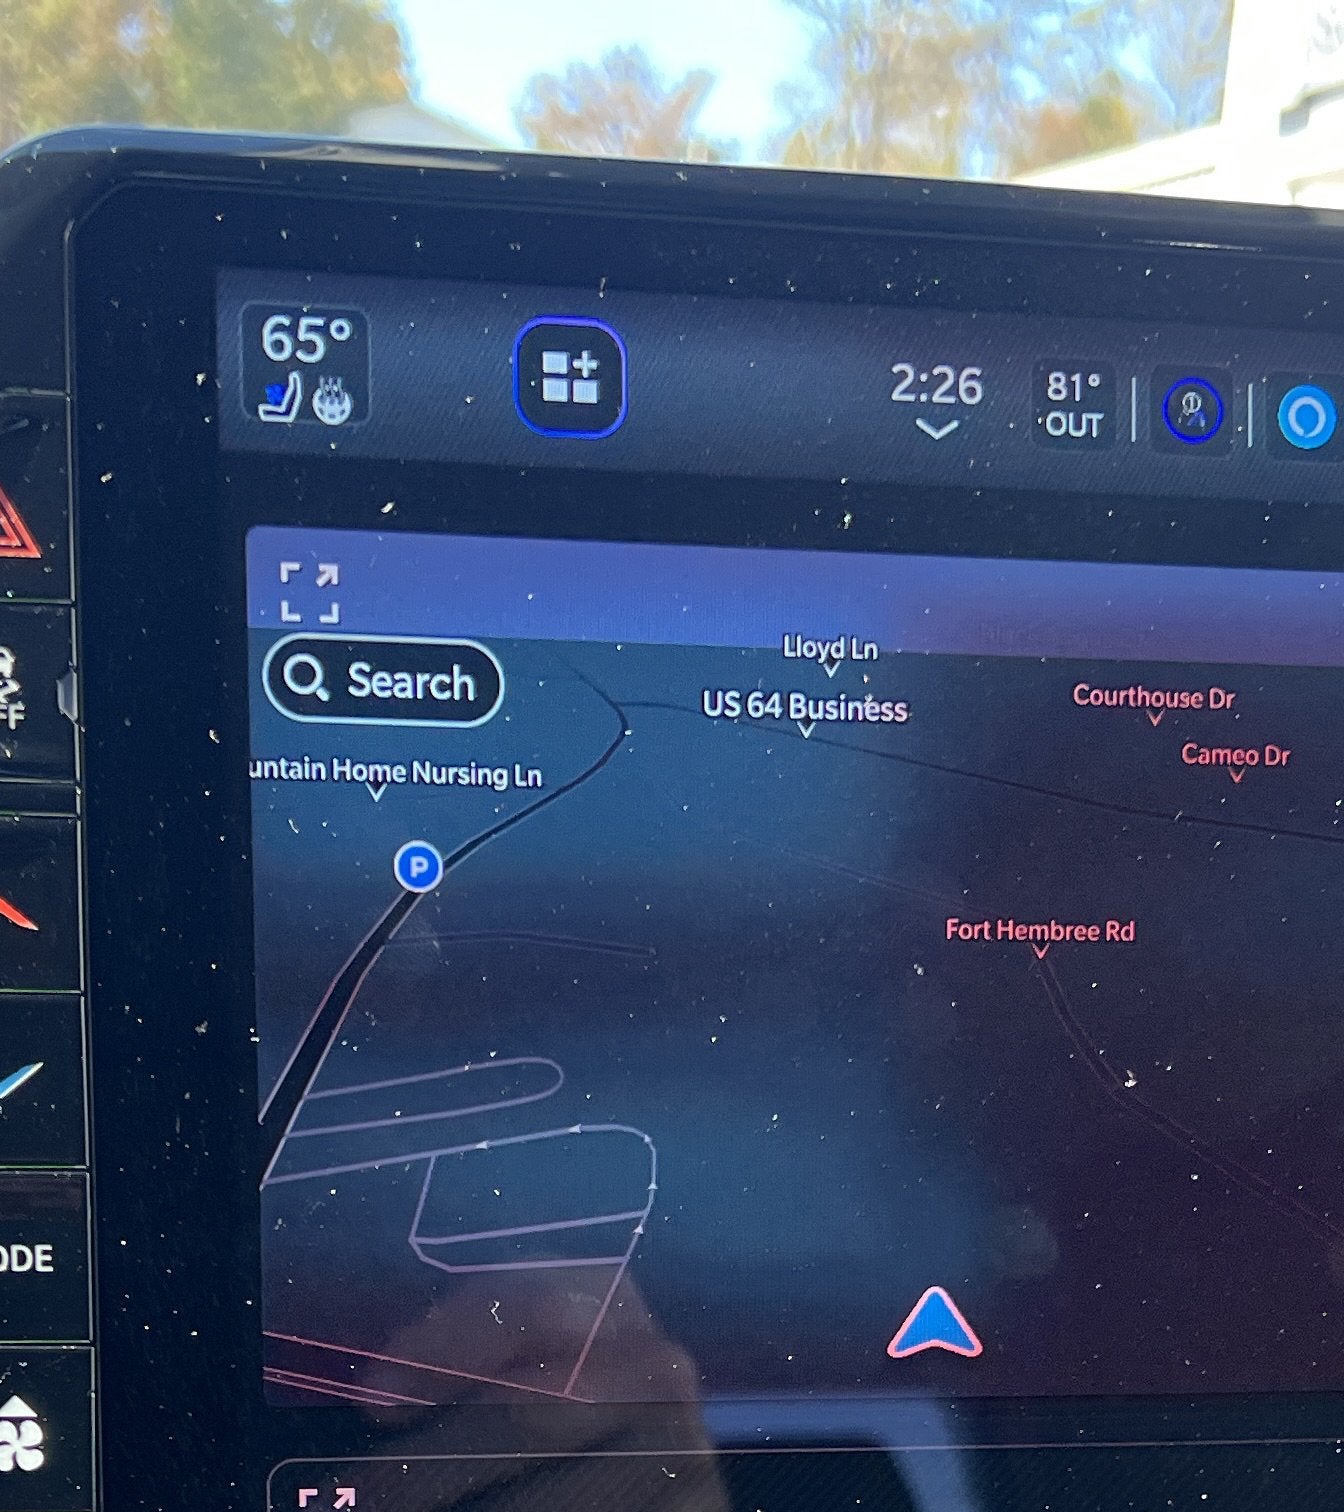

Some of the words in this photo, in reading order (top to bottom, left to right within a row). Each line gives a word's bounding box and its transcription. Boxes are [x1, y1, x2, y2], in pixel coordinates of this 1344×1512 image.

[890, 364, 984, 405] 2:26
[1046, 411, 1104, 439] OUT
[783, 634, 844, 664] Lloyd
[851, 636, 878, 660] Ln
[348, 662, 476, 702] Search
[703, 690, 741, 717] US
[747, 691, 782, 718] 64
[789, 692, 908, 722] Business
[1073, 684, 1204, 710] Courthouse
[1209, 688, 1236, 711] Dr
[1182, 743, 1259, 768] Cameo
[1265, 745, 1290, 768] Dr
[333, 758, 407, 783] Home
[412, 761, 508, 790] Nursing
[515, 764, 542, 787] Ln
[946, 918, 992, 940] Fort
[997, 919, 1100, 941] Hembree
[1106, 920, 1136, 942] Rd
